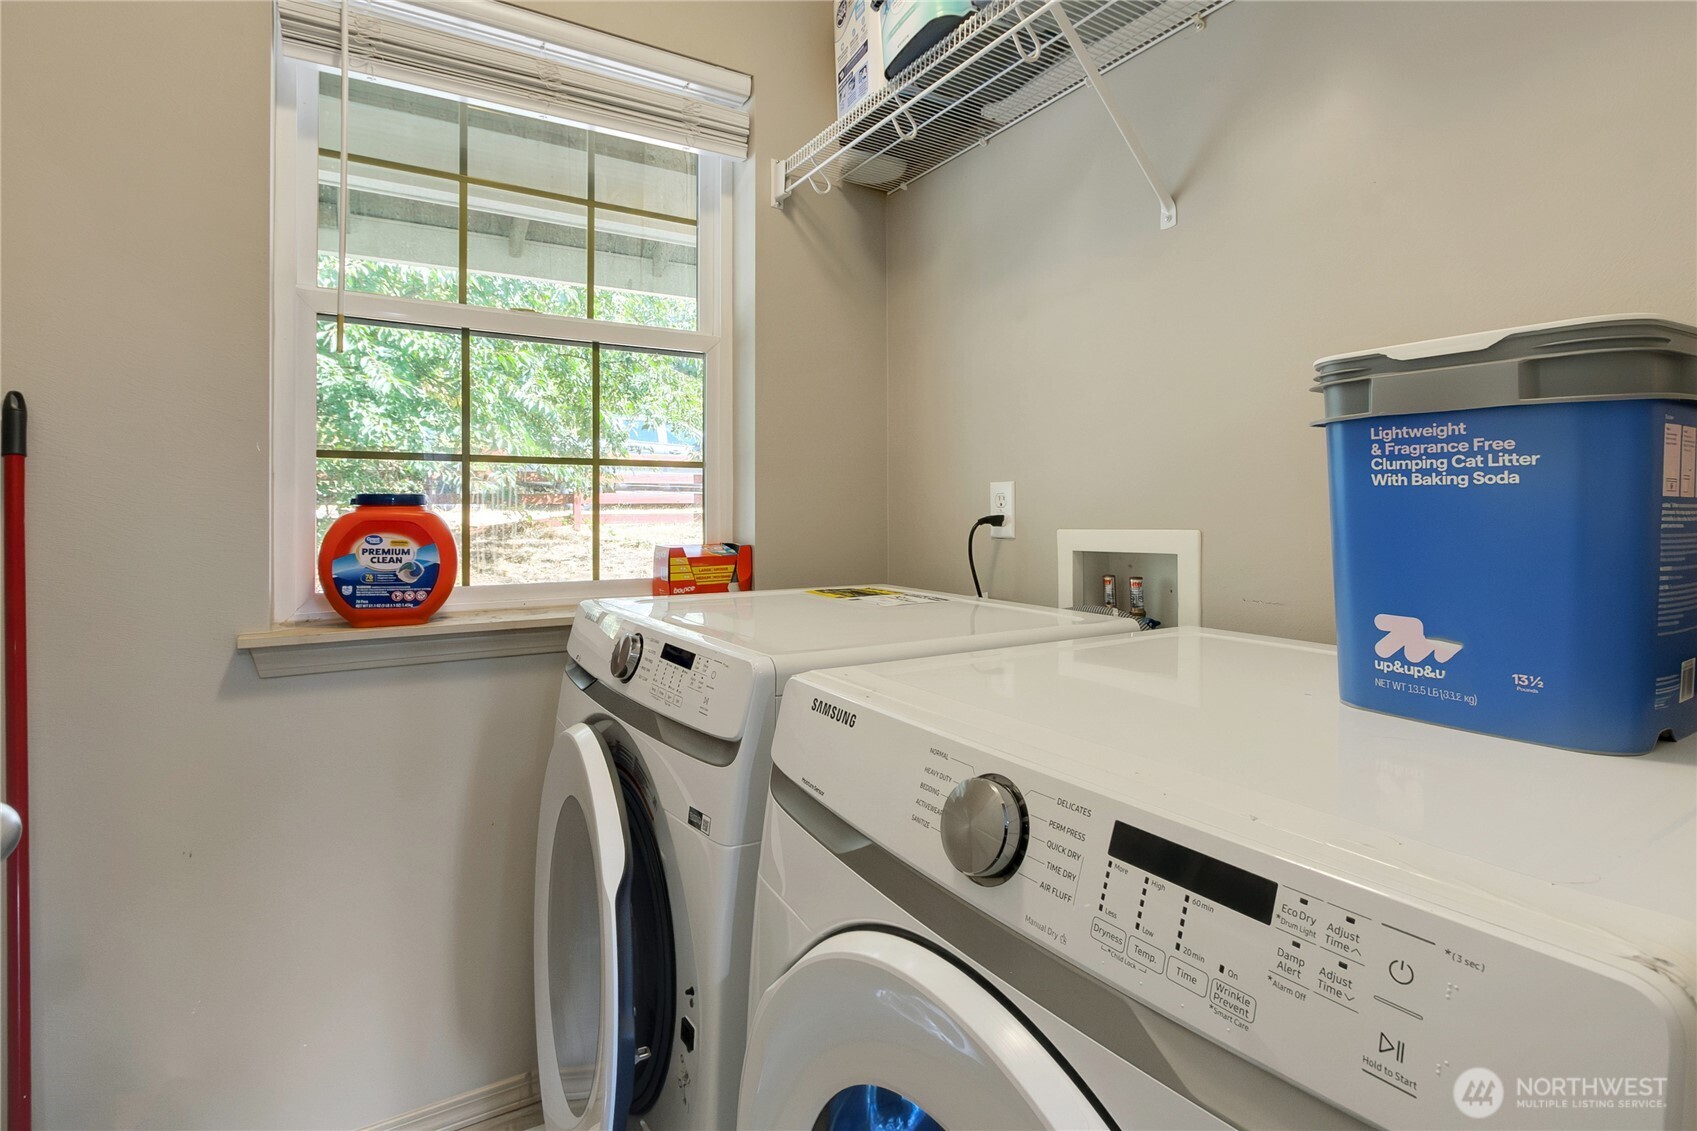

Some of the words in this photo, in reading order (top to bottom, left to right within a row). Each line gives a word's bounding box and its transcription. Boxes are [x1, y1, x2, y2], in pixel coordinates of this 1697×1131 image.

[1370, 422, 1467, 442] Lightweight
[1371, 443, 1382, 456] &
[1385, 441, 1469, 457] Fragrance
[1473, 437, 1516, 451] Free
[1370, 456, 1448, 472] Clumping
[1451, 454, 1484, 468] Cat
[1488, 452, 1541, 467] Litter
[1371, 473, 1408, 486] With
[1411, 472, 1469, 488] Baking
[1472, 470, 1520, 485] Soda
[361, 548, 411, 556] PREMIUM
[370, 556, 403, 564] CLEAN
[673, 586, 696, 594] bounce
[1374, 678, 1390, 688] NET
[1391, 681, 1406, 691] WT
[1407, 684, 1426, 695] 13.5
[1427, 687, 1440, 698] LB
[811, 698, 857, 728] SAMSUNG
[929, 747, 949, 761] NORMAL
[924, 766, 940, 778] HEAVY
[938, 772, 953, 783] DUTY
[920, 781, 941, 797] BEDDING
[1056, 798, 1092, 818] DELICATES
[911, 813, 931, 829] SANITIZE
[1048, 820, 1067, 835] PERM
[1064, 826, 1086, 842] PRESS
[1046, 840, 1065, 855] QUICK
[1064, 847, 1082, 862] DRY
[1046, 861, 1064, 876] TIME
[1061, 868, 1077, 882] DRY
[1114, 863, 1129, 875] More
[1039, 881, 1053, 894] AIR
[1051, 885, 1073, 903] FLUFF
[1151, 880, 1166, 892] High
[1104, 907, 1118, 919] Less
[1191, 898, 1201, 908] 60
[1200, 903, 1215, 914] min
[1281, 903, 1298, 918] Eco
[1299, 911, 1317, 927] Dry
[1025, 915, 1047, 933] Manual
[1047, 927, 1059, 940] Dry
[1093, 923, 1124, 946] Dryness
[1142, 926, 1155, 938] Low
[1299, 925, 1317, 938] Light
[1326, 923, 1361, 944] Adjust
[1133, 943, 1157, 964] Temp.
[1325, 934, 1350, 953] Time
[1123, 957, 1137, 969] Lock
[1182, 946, 1192, 957] 20
[1191, 952, 1206, 964] min
[1277, 946, 1305, 968] Damp
[1176, 966, 1198, 985] Time
[1227, 969, 1239, 981] On
[1276, 960, 1302, 980] Alert
[1318, 967, 1353, 990] Adjust
[1215, 982, 1252, 1008] Wrinkle
[1294, 989, 1307, 1002] Off
[1318, 978, 1343, 999] Time
[1212, 993, 1250, 1019] Prevent
[1232, 1016, 1250, 1031] Care
[1362, 1055, 1384, 1073] Hold
[1383, 1065, 1394, 1079] to
[1394, 1069, 1418, 1091] Start
